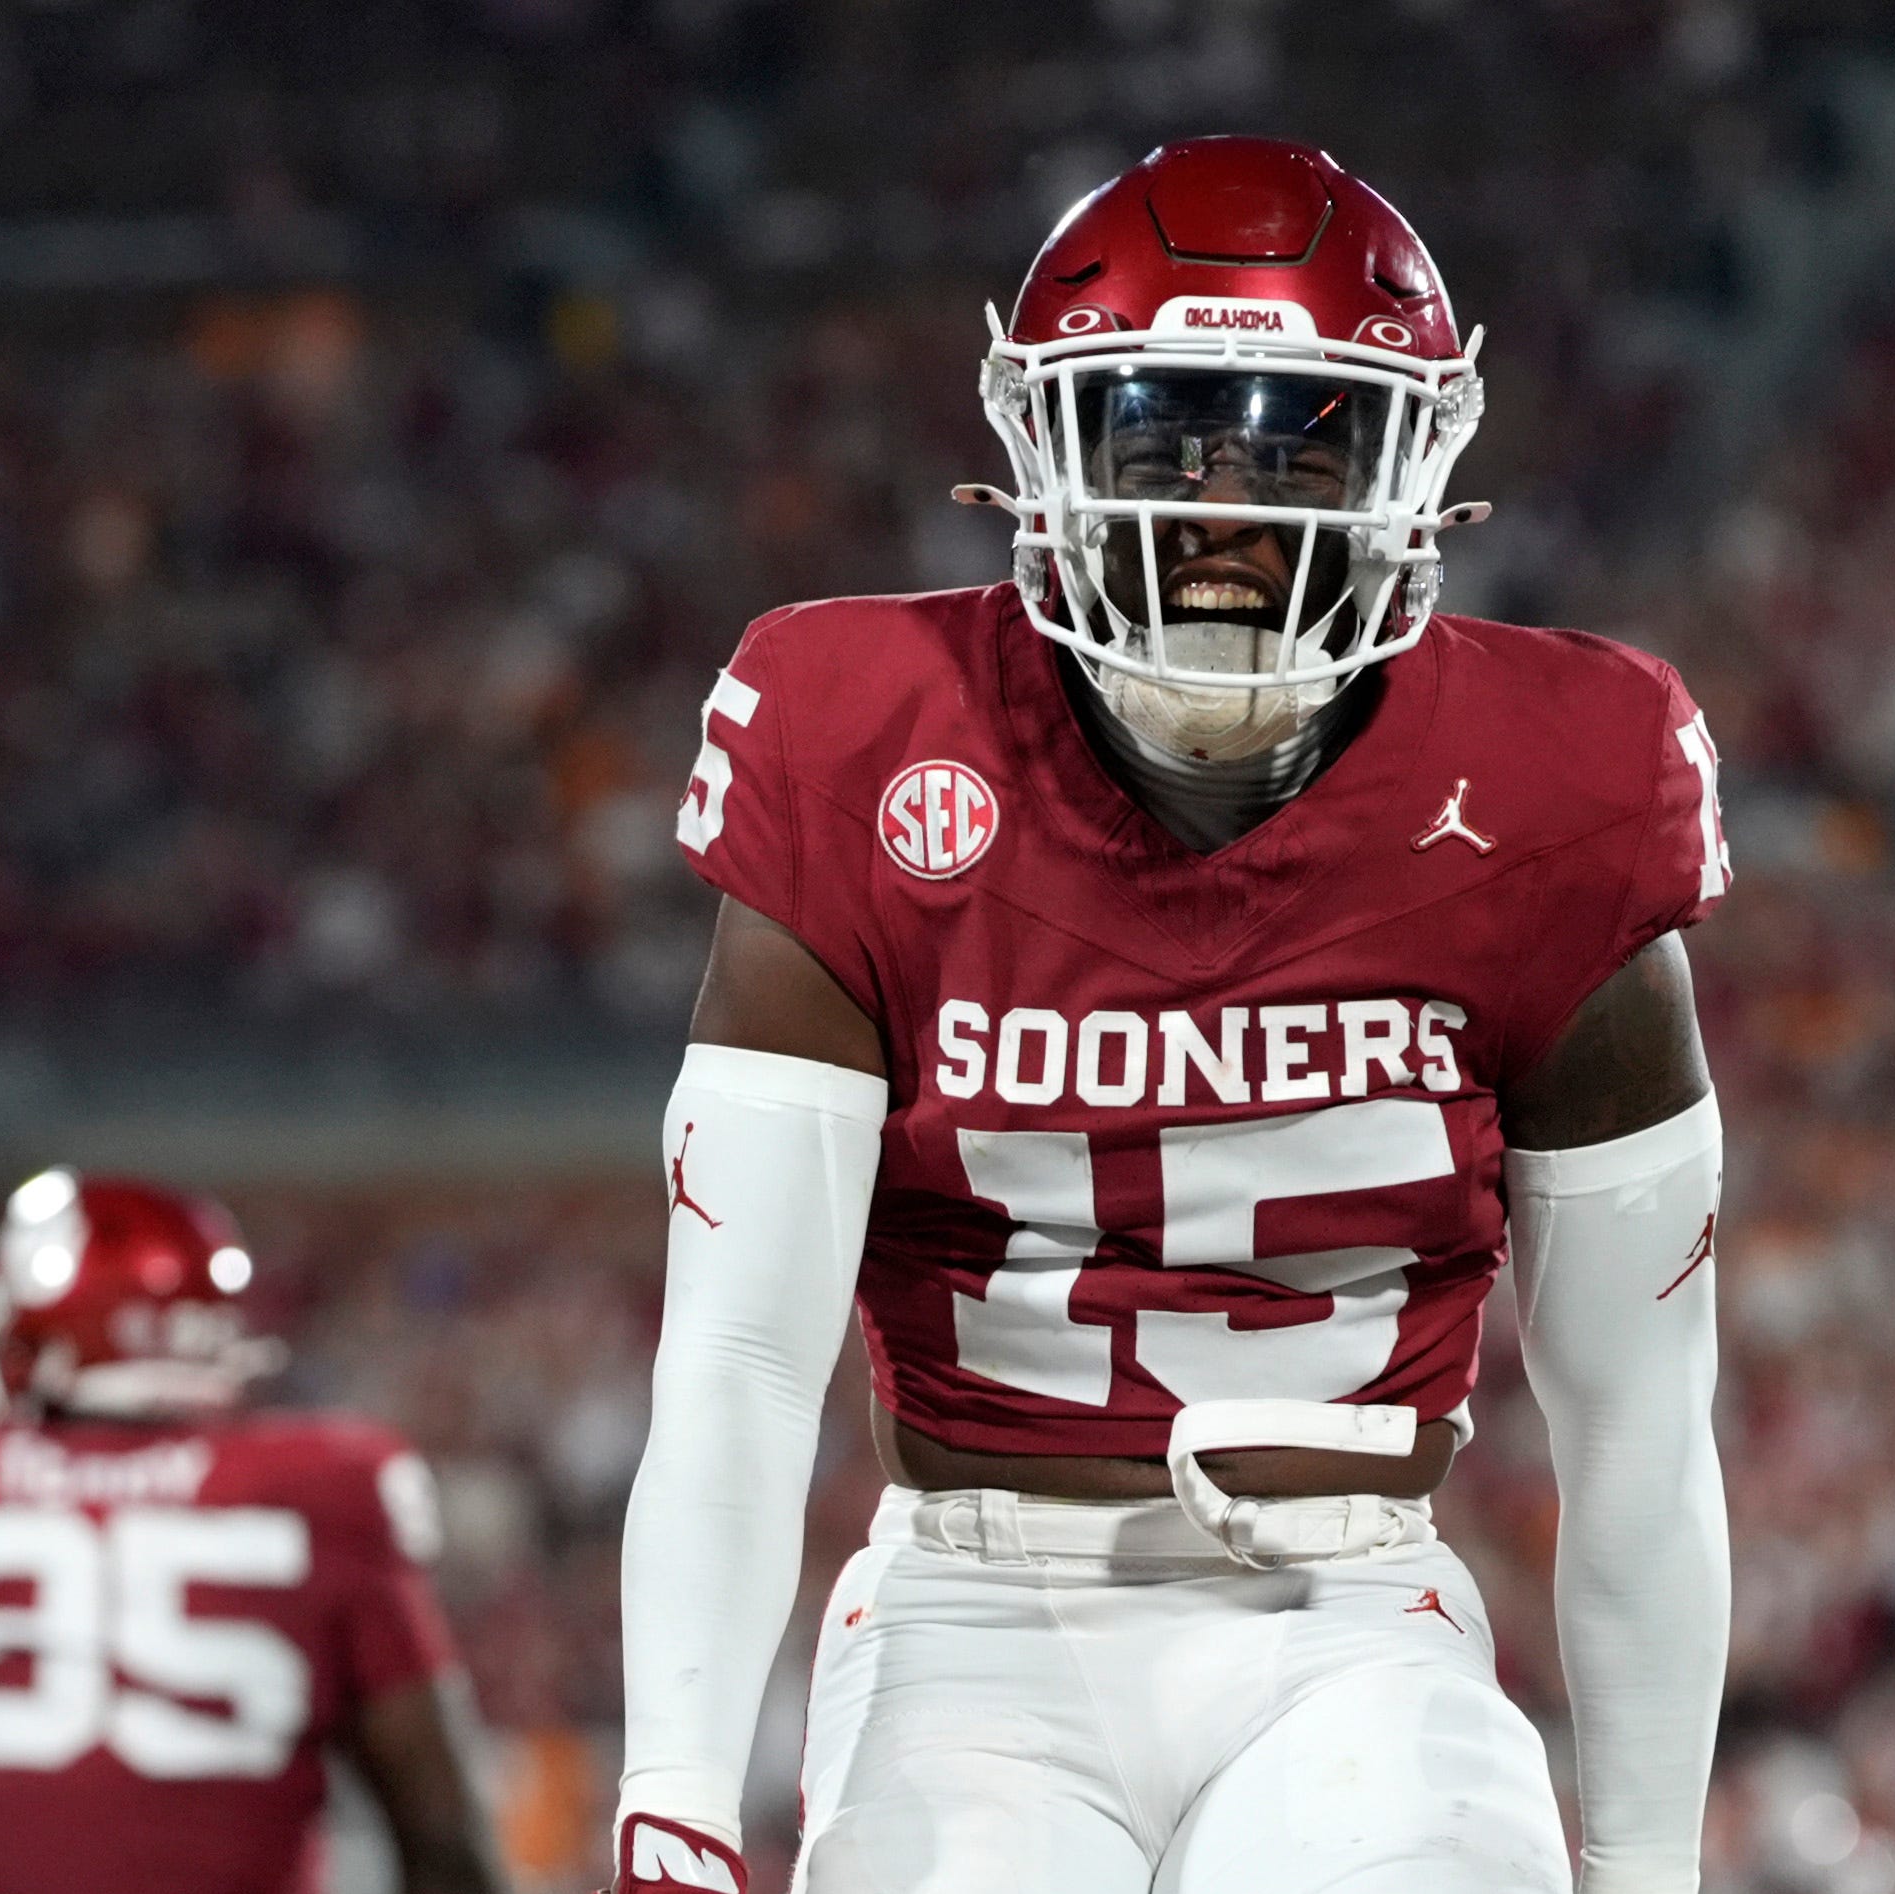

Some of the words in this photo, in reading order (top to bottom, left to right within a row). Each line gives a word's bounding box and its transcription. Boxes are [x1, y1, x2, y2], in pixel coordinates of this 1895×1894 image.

[1185, 308, 1283, 331] OKLAHOMA
[888, 769, 986, 870] SEC
[1675, 709, 1734, 902] 1
[937, 1000, 1467, 1107] SOONERS
[954, 1099, 1455, 1406] 15
